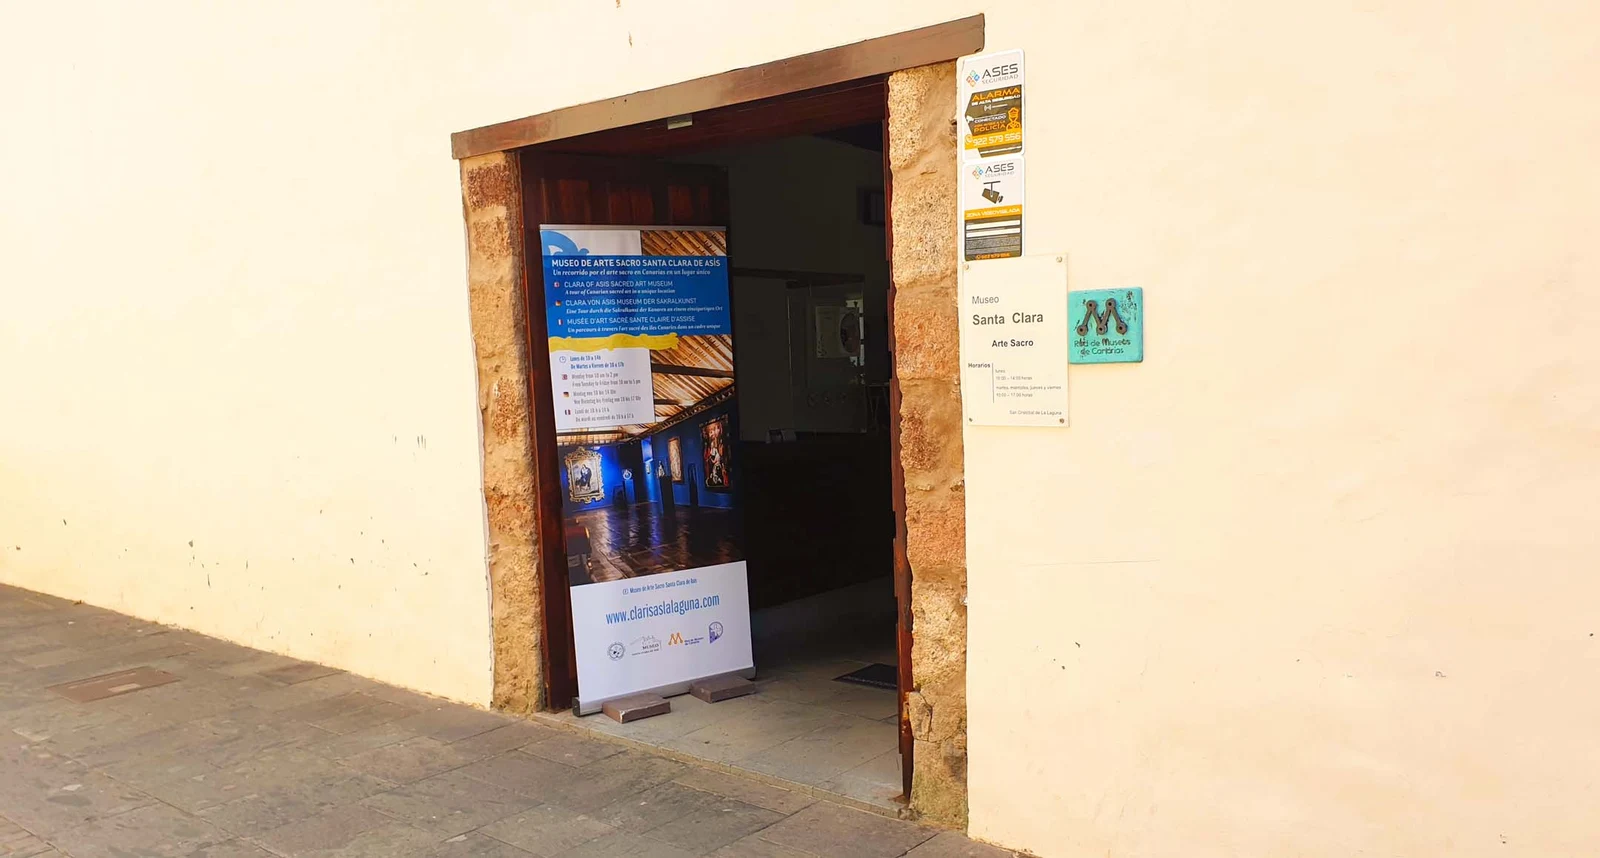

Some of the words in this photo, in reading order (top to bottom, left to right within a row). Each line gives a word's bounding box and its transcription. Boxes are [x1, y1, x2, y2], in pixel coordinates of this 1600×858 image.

[982, 63, 1018, 79] ASES
[982, 74, 1019, 85] SEGURIDAD
[972, 87, 1020, 101] ALARMA
[974, 123, 1006, 133] POLICÍA
[973, 138, 988, 146] 922
[988, 135, 1004, 144] 579
[1004, 132, 1021, 142] 556
[985, 162, 1015, 174] ASES
[551, 259, 579, 267] MUSEO
[581, 259, 592, 267] DE
[593, 259, 614, 267] ARTE
[642, 259, 667, 267] SANTA
[668, 259, 693, 267] CLARA
[693, 259, 704, 267] DE
[972, 296, 999, 304] Museo
[567, 317, 589, 325] MUSÉE
[972, 314, 1005, 325] Santa
[1012, 312, 1044, 324] Clara
[991, 339, 1008, 348] Arte
[1010, 339, 1034, 347] Sacro
[605, 594, 720, 624] www.clarisaslalaguna.com
